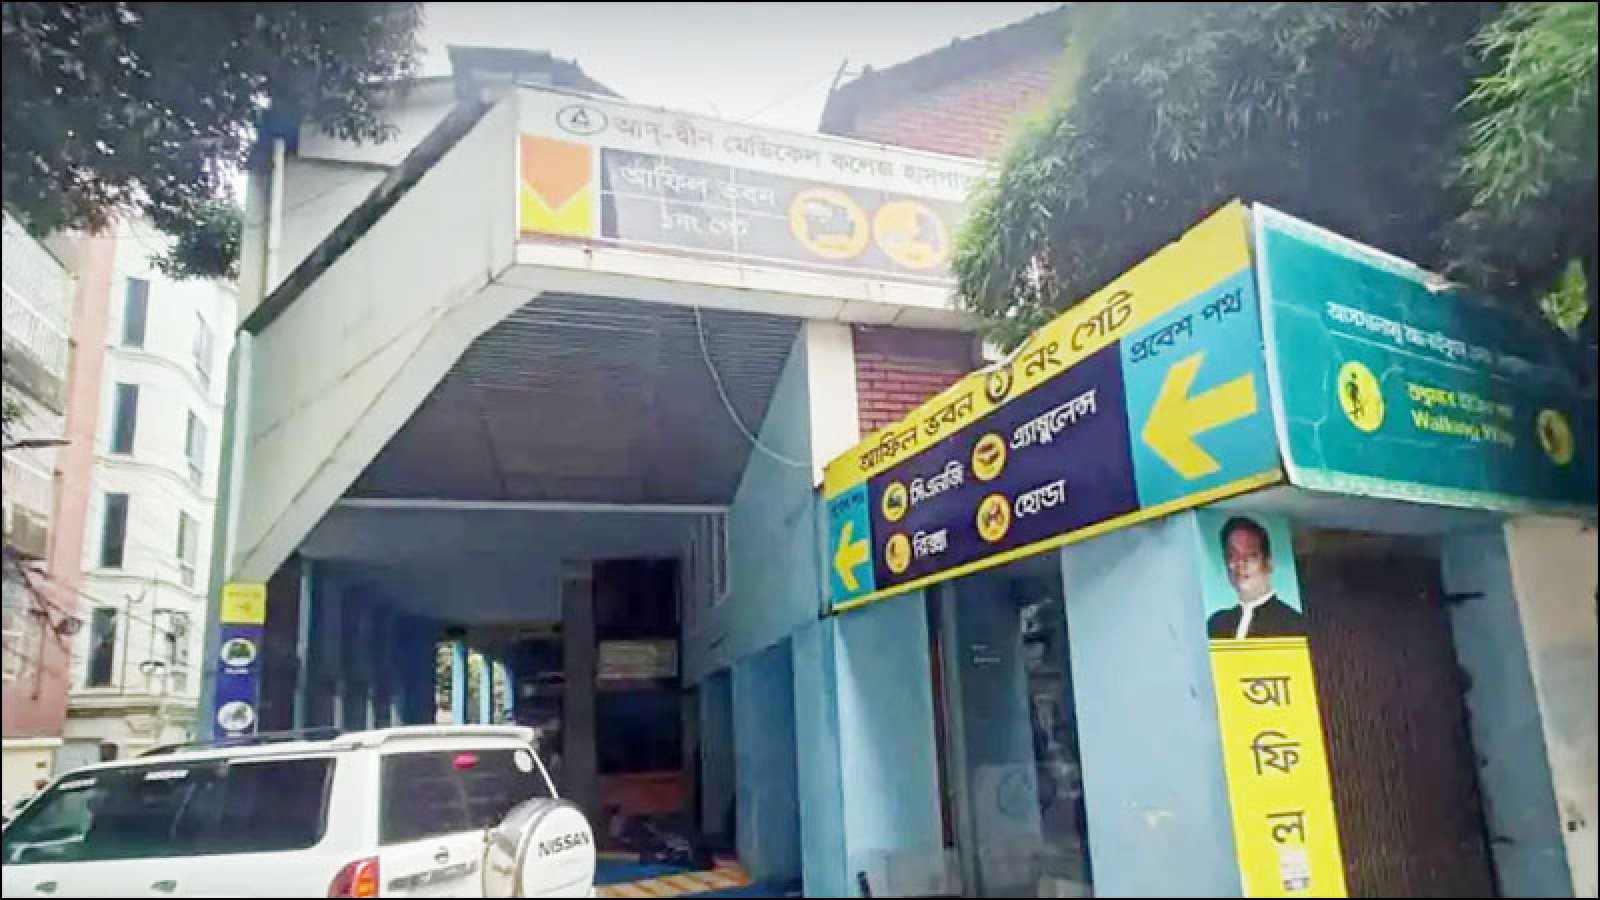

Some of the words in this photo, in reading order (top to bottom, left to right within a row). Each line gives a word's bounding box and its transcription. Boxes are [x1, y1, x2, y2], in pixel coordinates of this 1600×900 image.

[1129, 313, 1195, 364] প্রবেশ
[1200, 287, 1244, 325] পথ
[858, 430, 920, 472] আফিল
[922, 392, 974, 436] ভবন
[1021, 340, 1063, 378] নং
[1069, 288, 1133, 353] গেট
[538, 831, 590, 860] NISSAN
